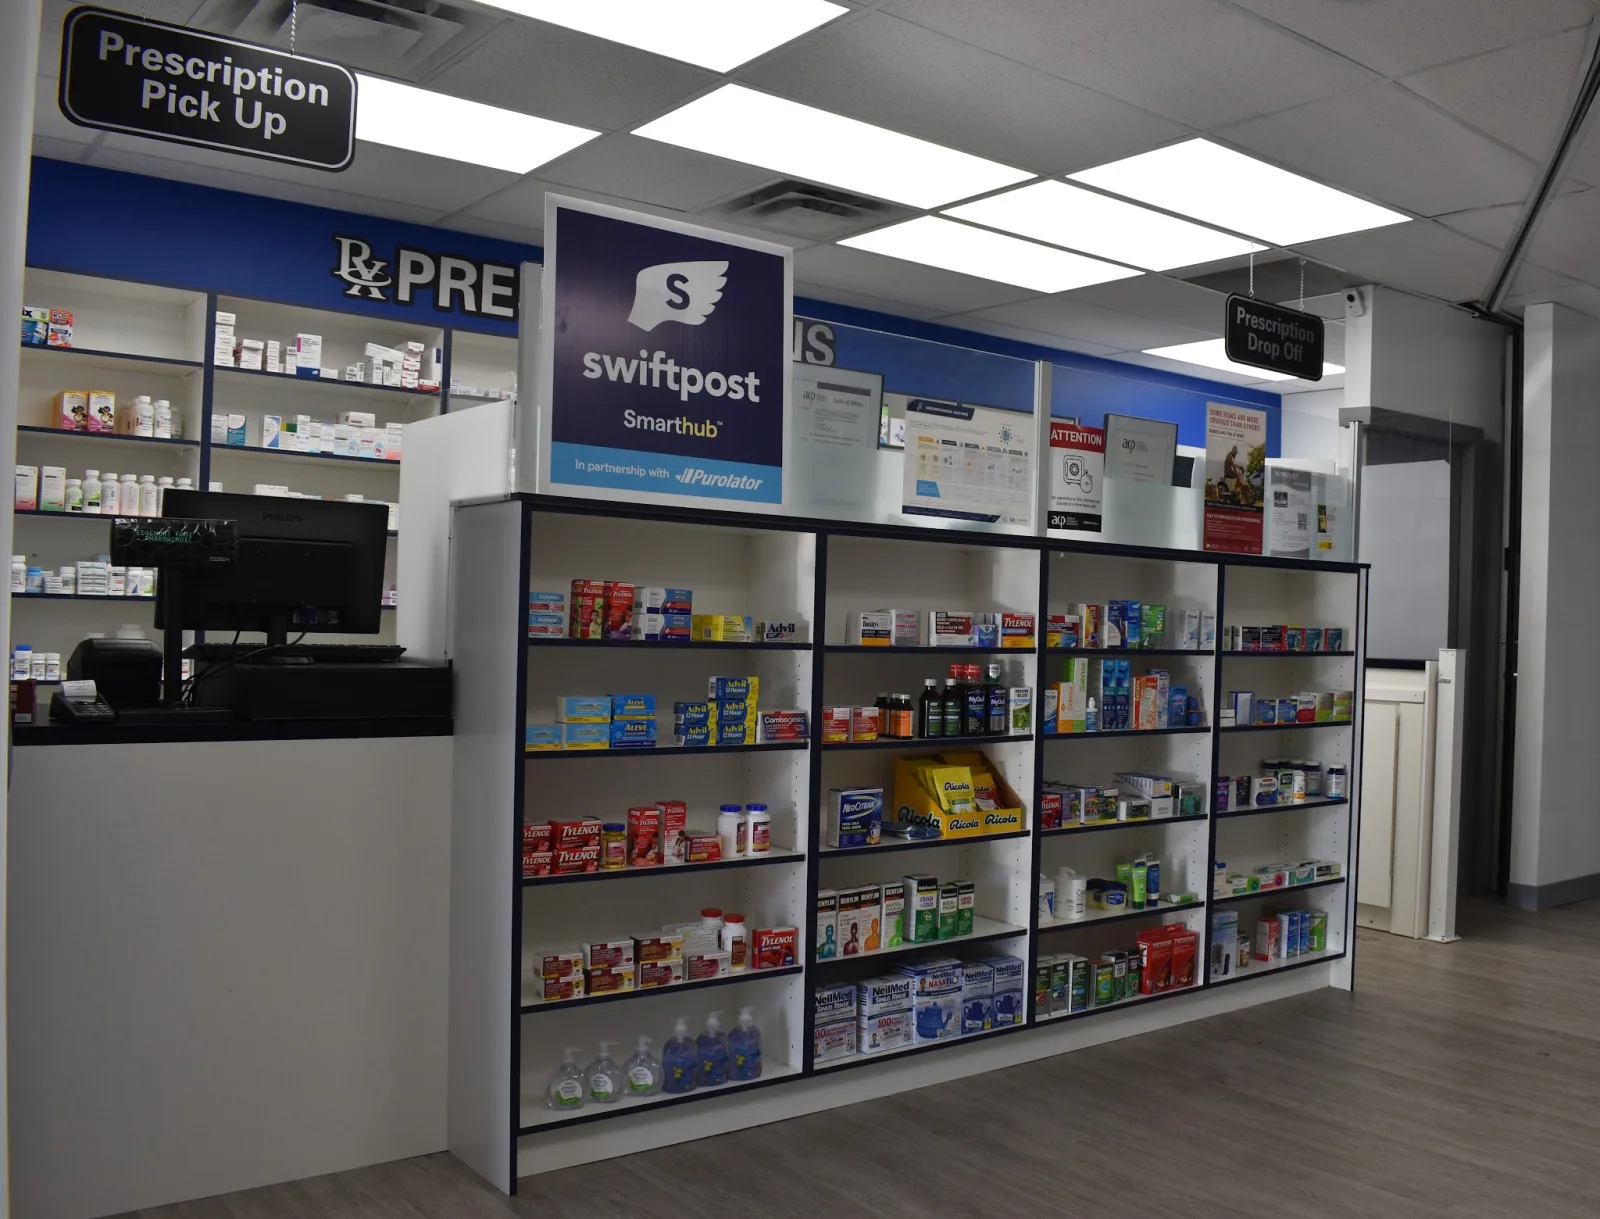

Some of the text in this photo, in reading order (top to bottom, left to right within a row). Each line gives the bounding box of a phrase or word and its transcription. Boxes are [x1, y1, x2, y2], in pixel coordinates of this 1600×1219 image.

[98, 30, 328, 107] Prescription
[141, 78, 287, 140] Pick Up
[398, 249, 519, 318] PRE
[22, 307, 33, 318] ix
[1236, 306, 1314, 344] Prescription
[1248, 333, 1304, 363] Drop Off
[582, 348, 761, 403] swiftpost
[1210, 409, 1222, 417] SOME
[1223, 411, 1236, 420] RISKS
[1247, 416, 1260, 425] MORE
[1210, 416, 1260, 432] OBVIOUS THAN OTHERS
[1050, 429, 1102, 446] ATTENTION
[575, 459, 763, 491] In partnership with Purolator
[262, 512, 303, 523] PHILIPS
[583, 587, 603, 595] TYLENOL
[768, 623, 795, 633] Advil
[1004, 617, 1033, 628] TYLENOL
[727, 679, 747, 688] Advil
[626, 698, 645, 706] ALEVE
[724, 702, 745, 710] Advil
[687, 705, 707, 713] Advil
[764, 716, 805, 726] Combogasic
[624, 723, 648, 732] ALEVE
[687, 726, 707, 734] Advil
[723, 724, 744, 733] Advil
[944, 781, 970, 792] Ricola
[897, 805, 941, 832] Ricola
[985, 813, 1017, 827] Ricola
[949, 818, 979, 832] Ricola
[523, 830, 550, 838] YLENOL
[562, 825, 600, 837] TYLENOL
[559, 850, 598, 863] TYLENOL
[840, 895, 859, 905] BENYLIN
[860, 891, 880, 901] BENYLIN
[817, 899, 836, 908] ENYLIN
[761, 936, 793, 947] TYLENOL
[1152, 939, 1172, 948] TENSOR
[1174, 936, 1195, 945] TENSOR
[996, 962, 1021, 973] NeilMed
[932, 970, 956, 980] NeilMed
[965, 970, 992, 980] NeilMed
[872, 982, 909, 997] NeilMed
[816, 990, 852, 1005] NeilMed
[875, 991, 907, 1004] SINUS RINSE
[817, 1000, 850, 1013] SINUS RINSE
[877, 1017, 892, 1029] 100
[815, 1028, 826, 1040] 00
